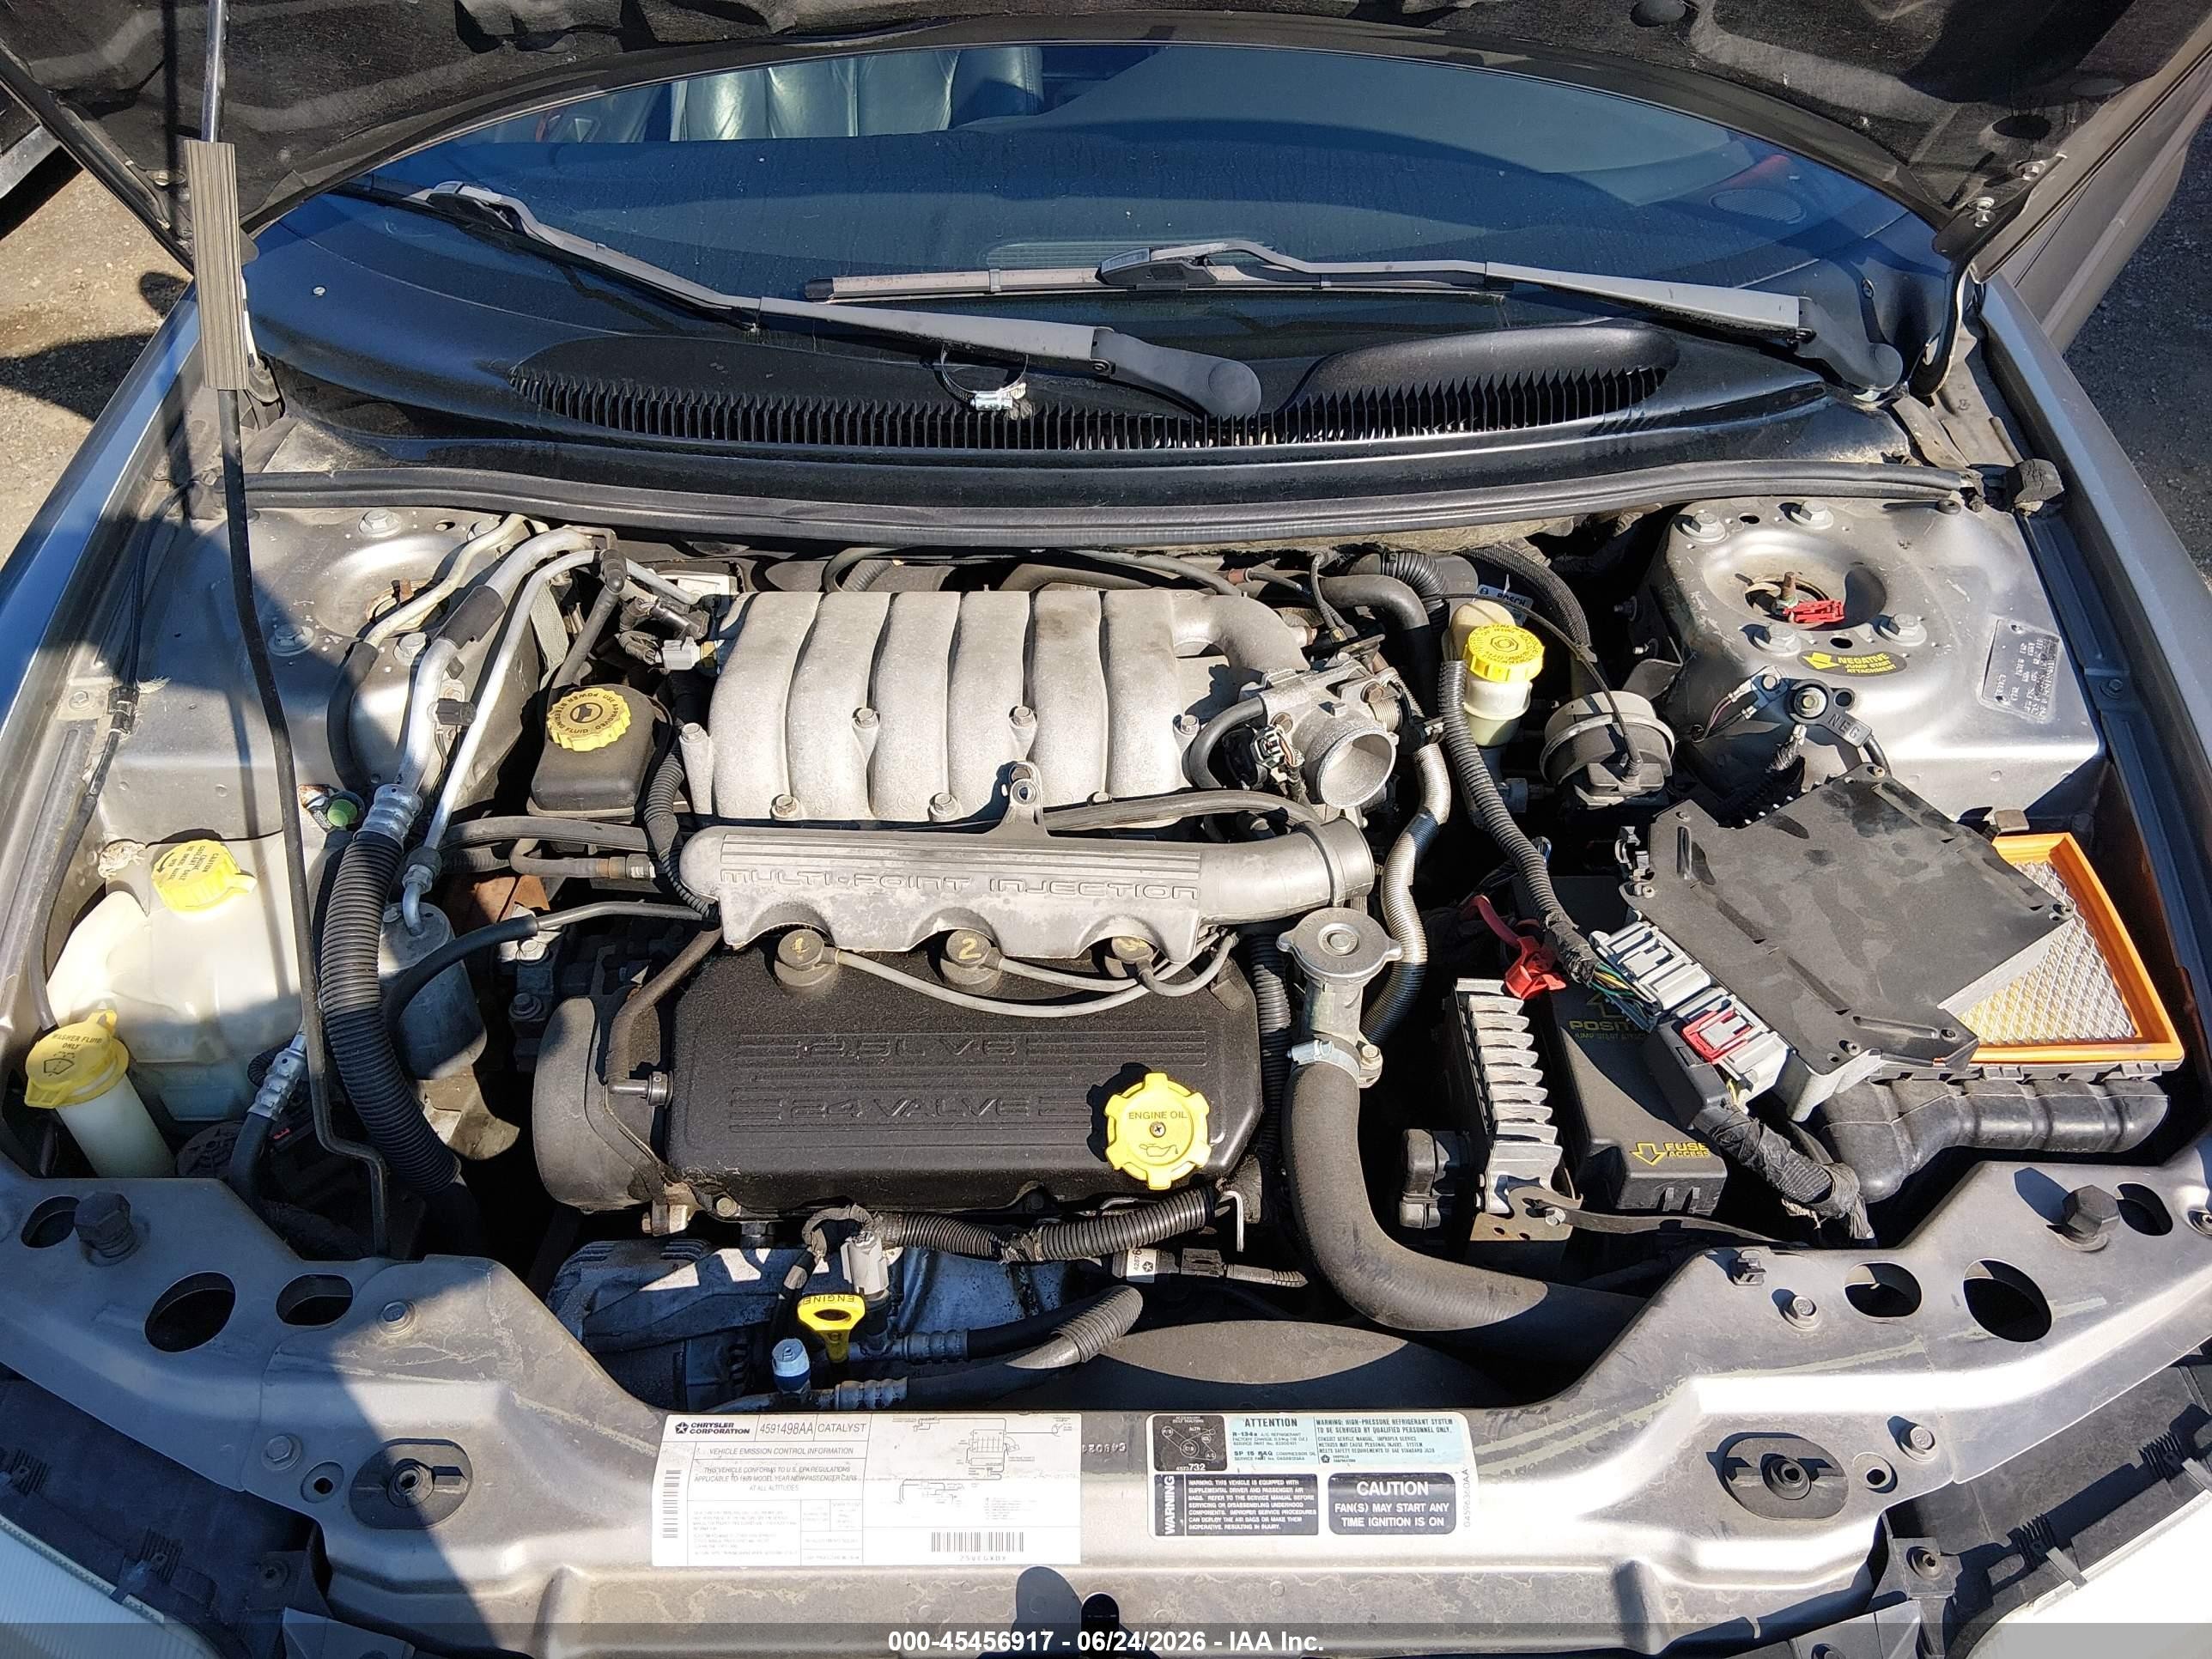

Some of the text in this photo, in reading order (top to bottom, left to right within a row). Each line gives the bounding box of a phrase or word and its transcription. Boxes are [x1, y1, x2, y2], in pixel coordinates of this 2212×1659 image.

[1838, 653, 1890, 665] NEGATIVE
[567, 692, 599, 702] POWER
[603, 694, 616, 703] USE
[1828, 714, 1860, 738] NEG
[988, 878, 1200, 902] INJECTION
[959, 938, 982, 960] 2
[872, 1097, 1031, 1118] VALVE
[1128, 1111, 1168, 1120] ENGINE
[1663, 1142, 1709, 1151] FUSE
[803, 1295, 855, 1305] ENGINE
[817, 1423, 867, 1432] CATALYST
[1245, 1419, 1297, 1427] ATTENTION
[759, 1423, 814, 1435] 4591498AA
[1356, 1481, 1429, 1496] CAUTION
[1164, 1475, 1175, 1535] WARNING
[1334, 1503, 1449, 1513] FAN(S) MAY START ANY
[1341, 1517, 1444, 1527] TIME IGNITION IS ON
